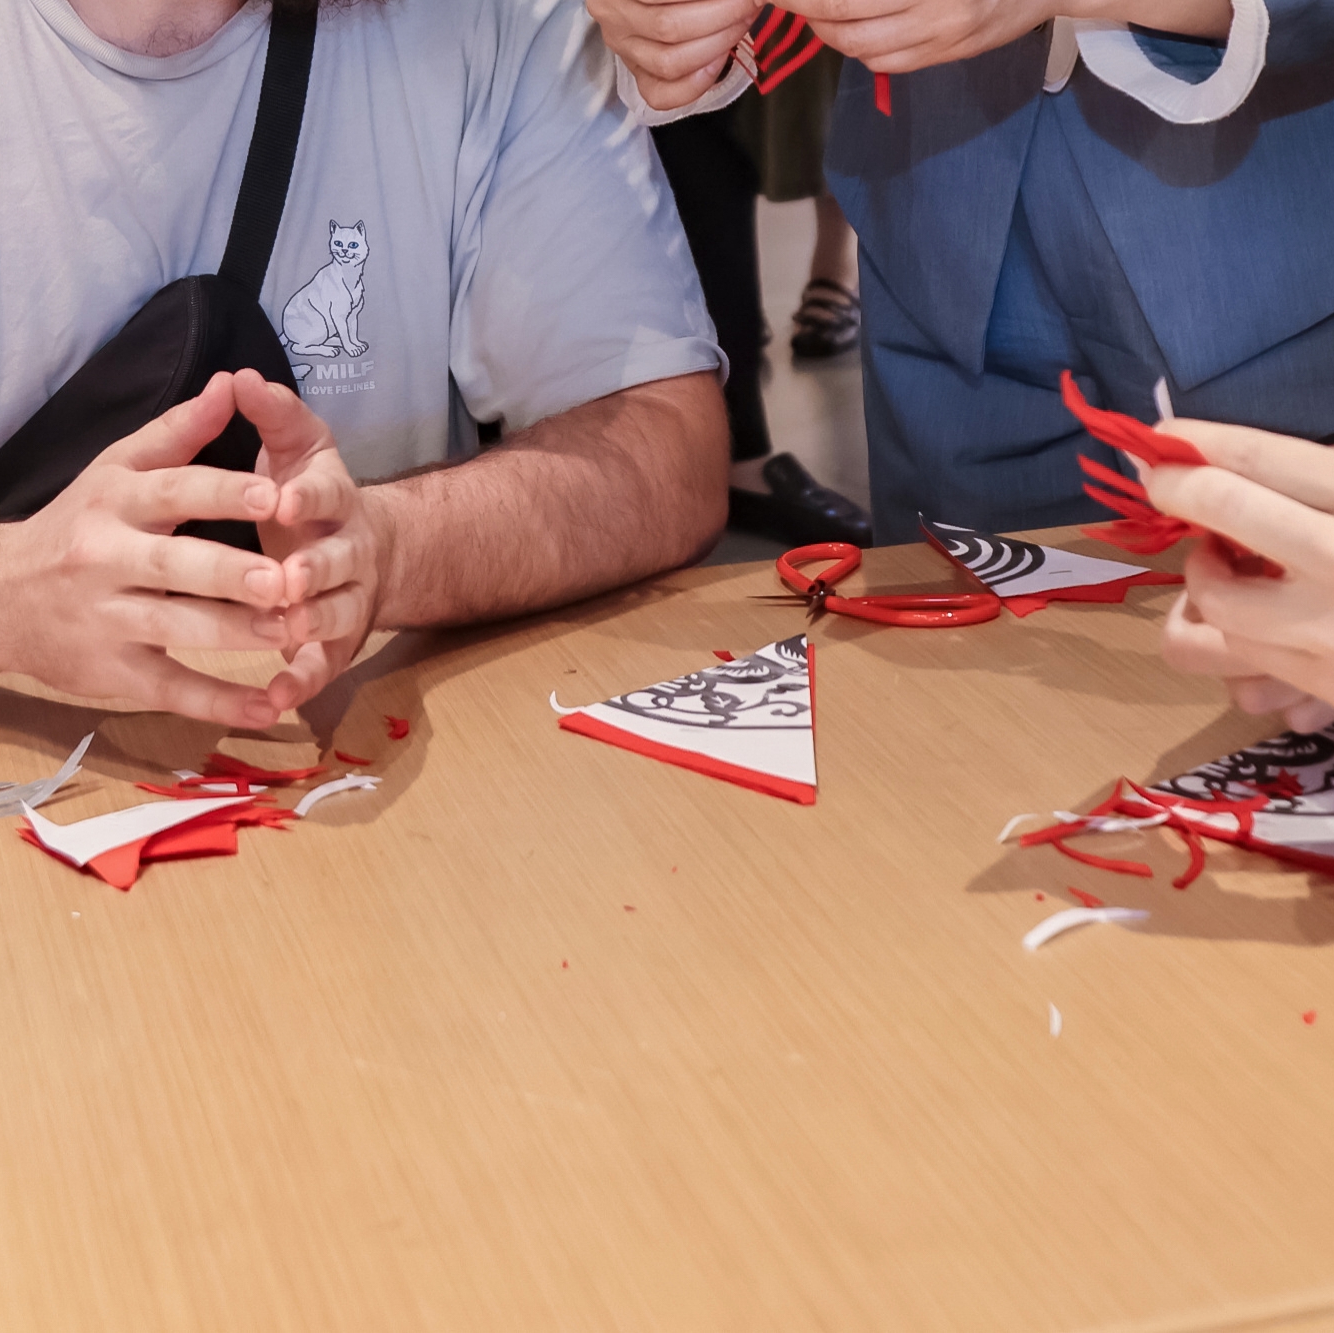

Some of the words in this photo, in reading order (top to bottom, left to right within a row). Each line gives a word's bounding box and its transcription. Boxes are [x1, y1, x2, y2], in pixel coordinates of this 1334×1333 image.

[316, 360, 375, 380] MILF
[306, 384, 334, 395] LOVE
[335, 380, 376, 395] FELINES
